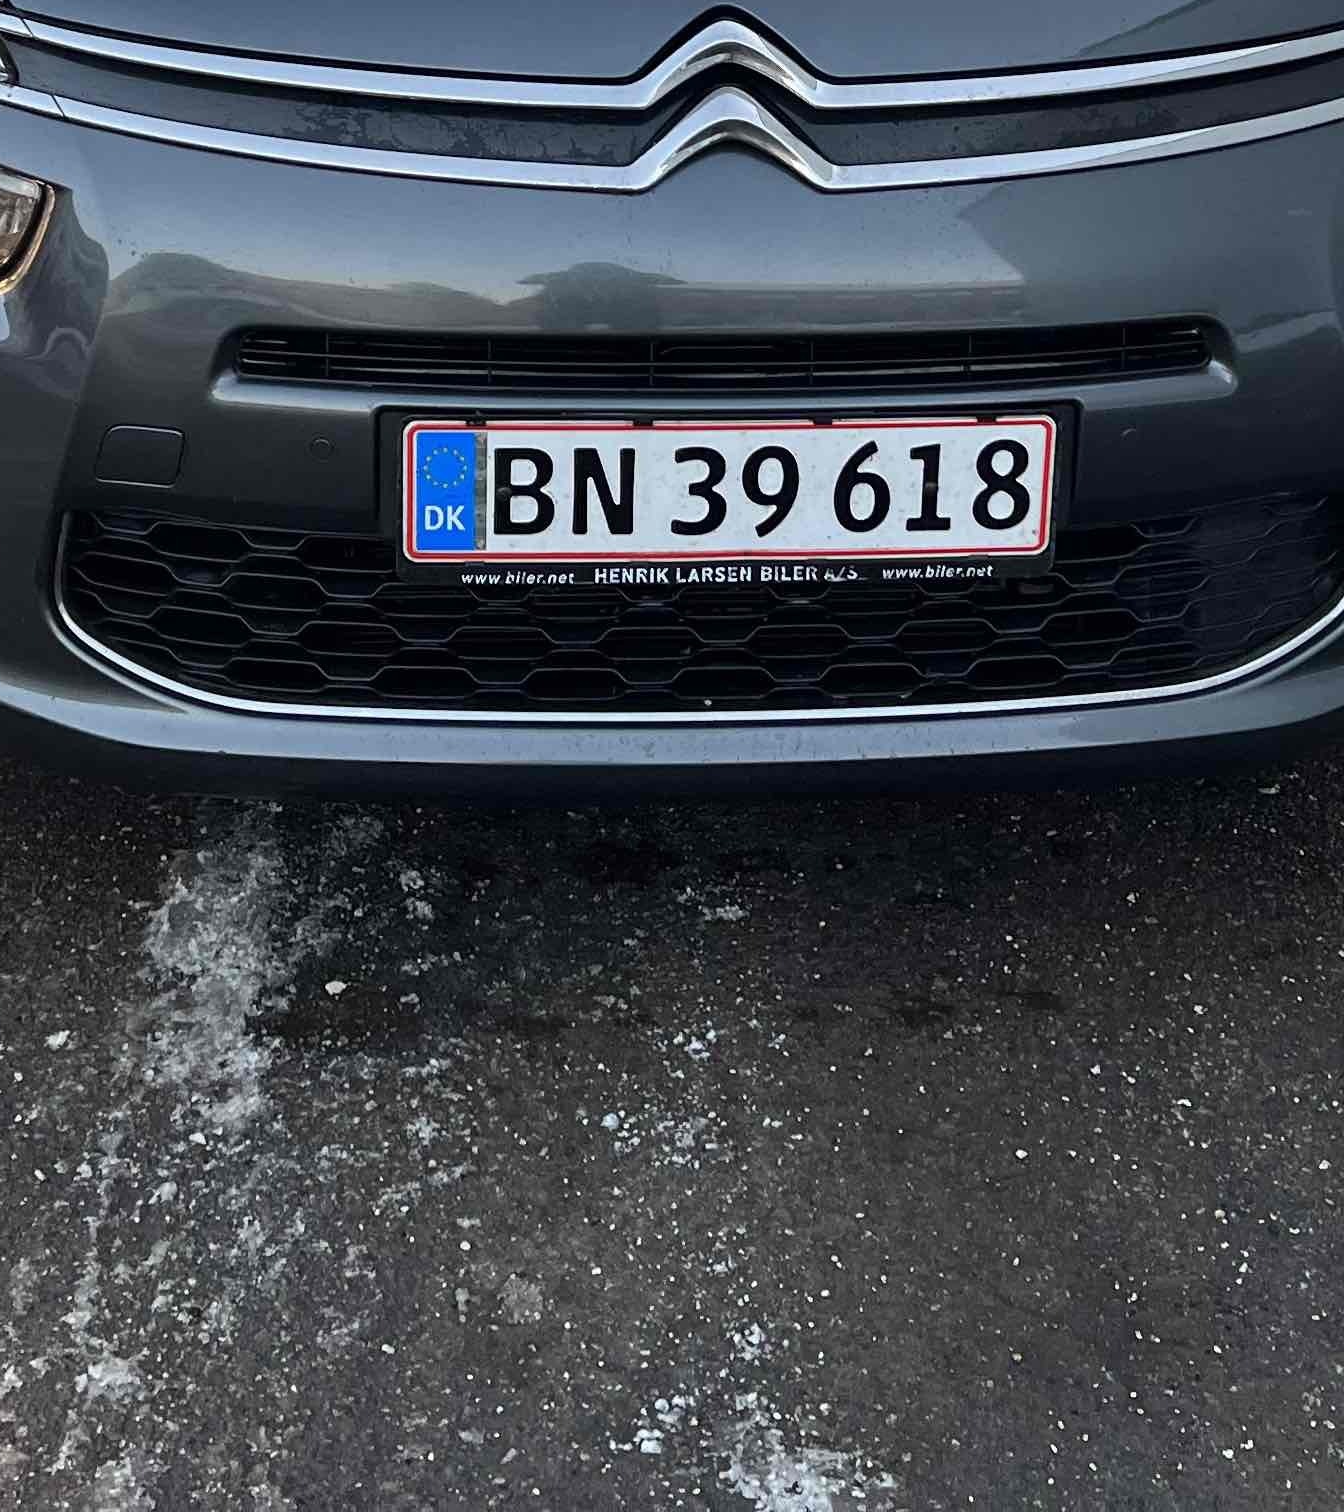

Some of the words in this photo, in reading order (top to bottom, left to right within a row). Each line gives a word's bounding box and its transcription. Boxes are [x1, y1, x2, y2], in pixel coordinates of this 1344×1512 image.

[493, 447, 635, 535] BN
[670, 445, 800, 538] 39
[833, 439, 1031, 533] 618
[424, 504, 466, 531] DK
[594, 567, 670, 584] HENRIK
[675, 566, 752, 583] LARSEN
[760, 565, 818, 582] BILER
[882, 564, 995, 580] www.biler.net
